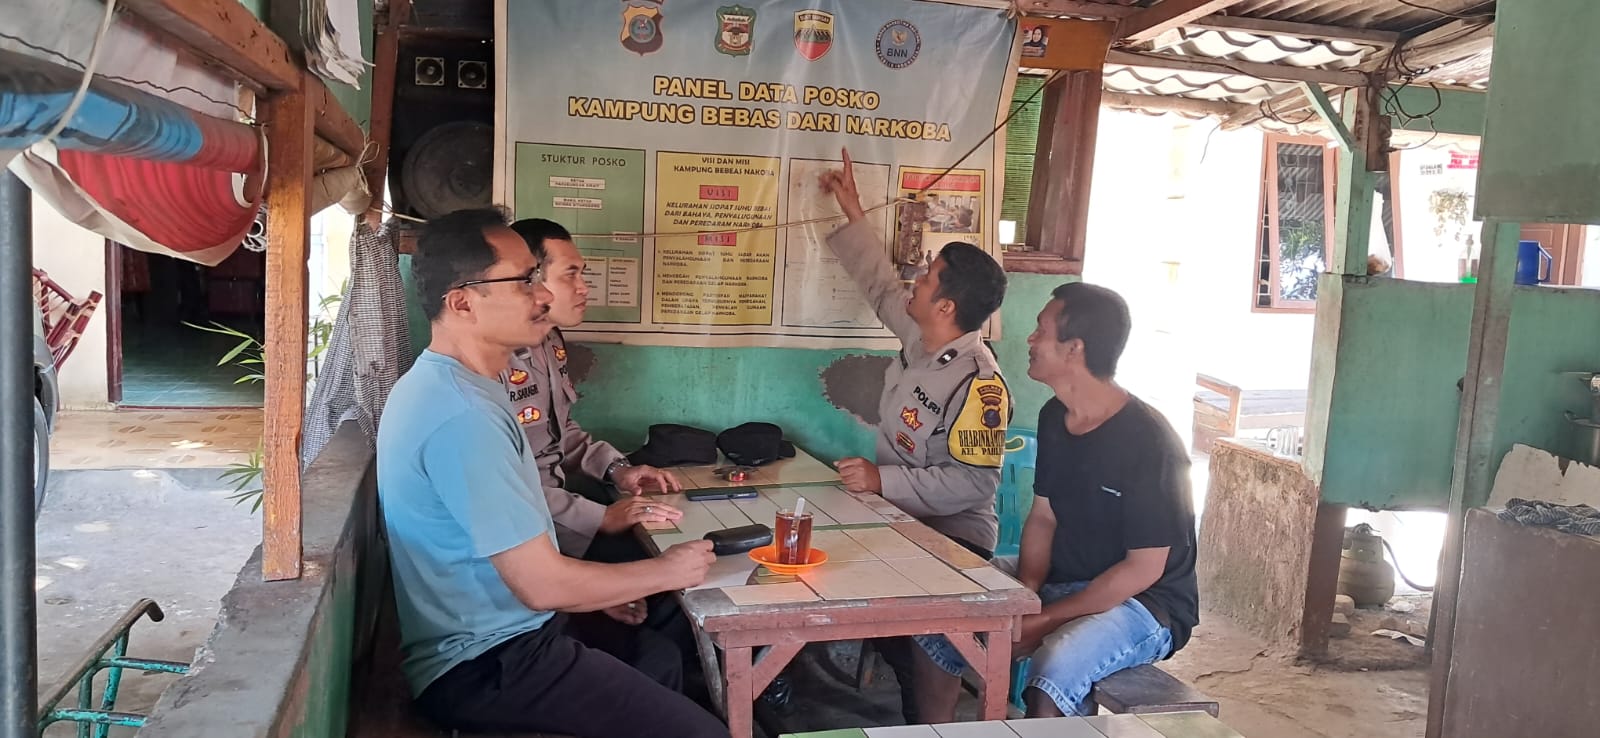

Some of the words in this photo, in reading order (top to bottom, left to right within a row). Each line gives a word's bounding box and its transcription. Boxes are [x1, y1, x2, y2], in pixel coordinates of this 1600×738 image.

[887, 48, 908, 58] BNN
[653, 75, 733, 100] PANEL
[738, 81, 798, 103] DATA
[803, 86, 880, 110] POSKO
[568, 96, 696, 125] KAMPUNG
[701, 106, 781, 128] BEBAS
[786, 111, 841, 132] DARI
[846, 115, 951, 142] NARKOBA
[541, 153, 586, 165] STUKTUR
[592, 156, 626, 167] POSKO
[674, 165, 713, 174] KAMPUNG
[714, 167, 742, 175] BEBEAS
[665, 201, 708, 210] KELURAHAN
[912, 385, 942, 416] POLRI
